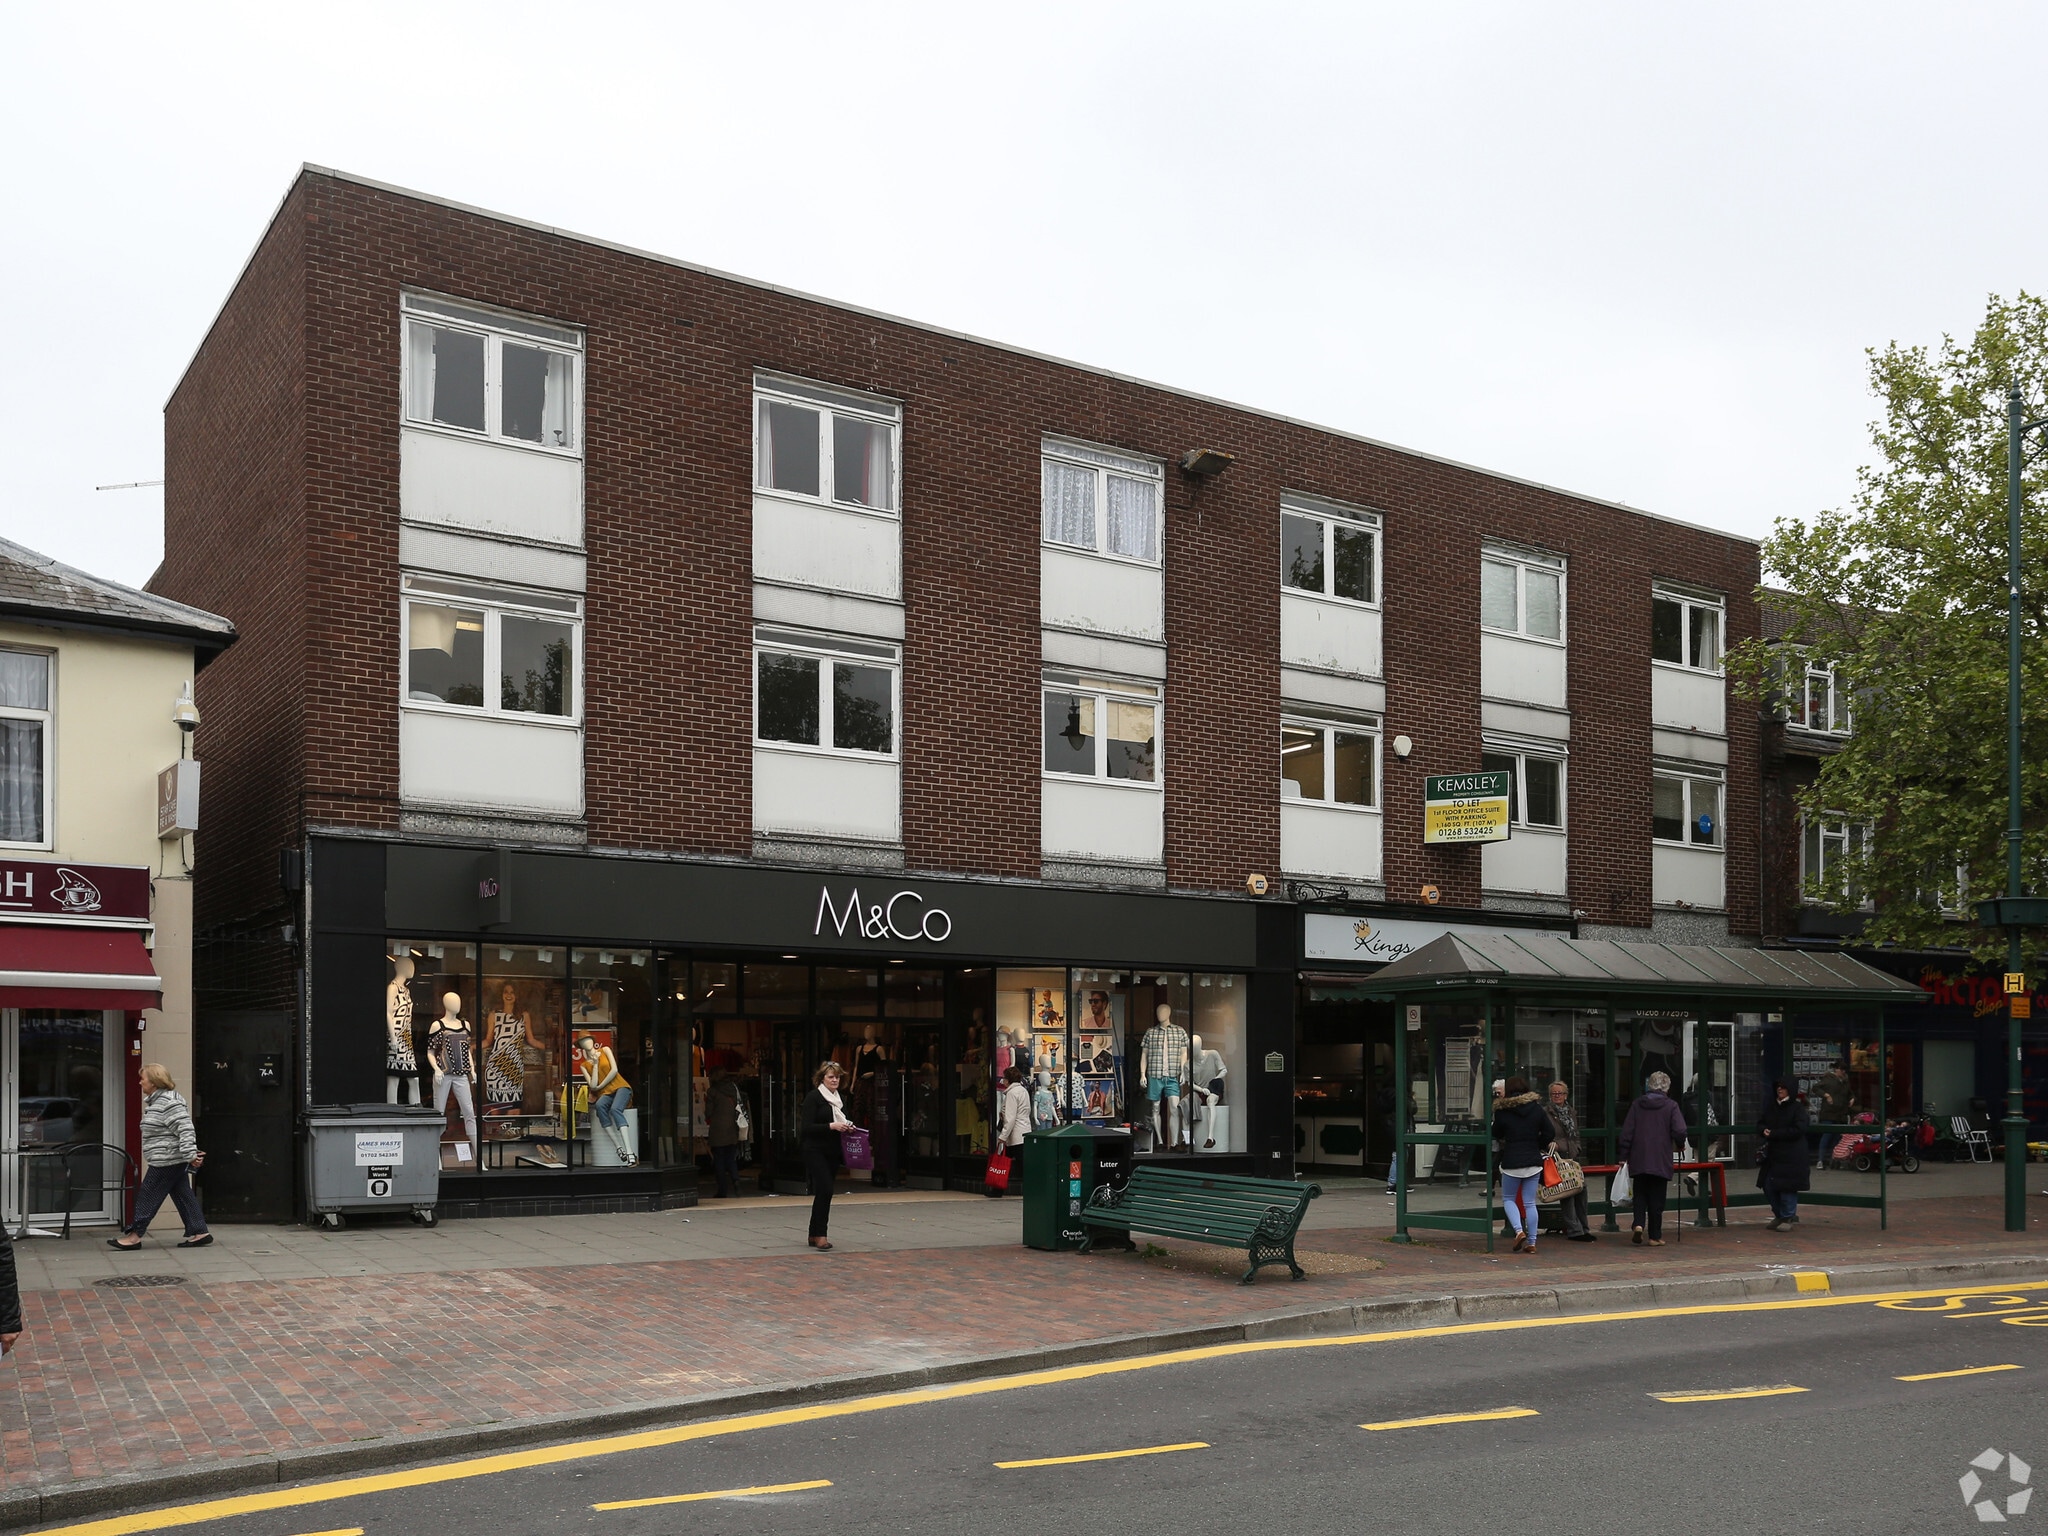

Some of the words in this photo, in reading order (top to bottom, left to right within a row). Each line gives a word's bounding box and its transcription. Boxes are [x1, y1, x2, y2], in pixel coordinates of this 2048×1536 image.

[1437, 776, 1498, 792] KEMSLEY
[1453, 800, 1465, 808] TO
[1467, 799, 1480, 807] LET
[1438, 828, 1462, 837] 01268
[1464, 827, 1493, 836] 532425
[0, 871, 33, 897] H
[815, 886, 952, 942] M&Co
[1354, 930, 1416, 961] Kings
[1919, 975, 2034, 1007] FACTO
[1973, 999, 2004, 1019] Shop
